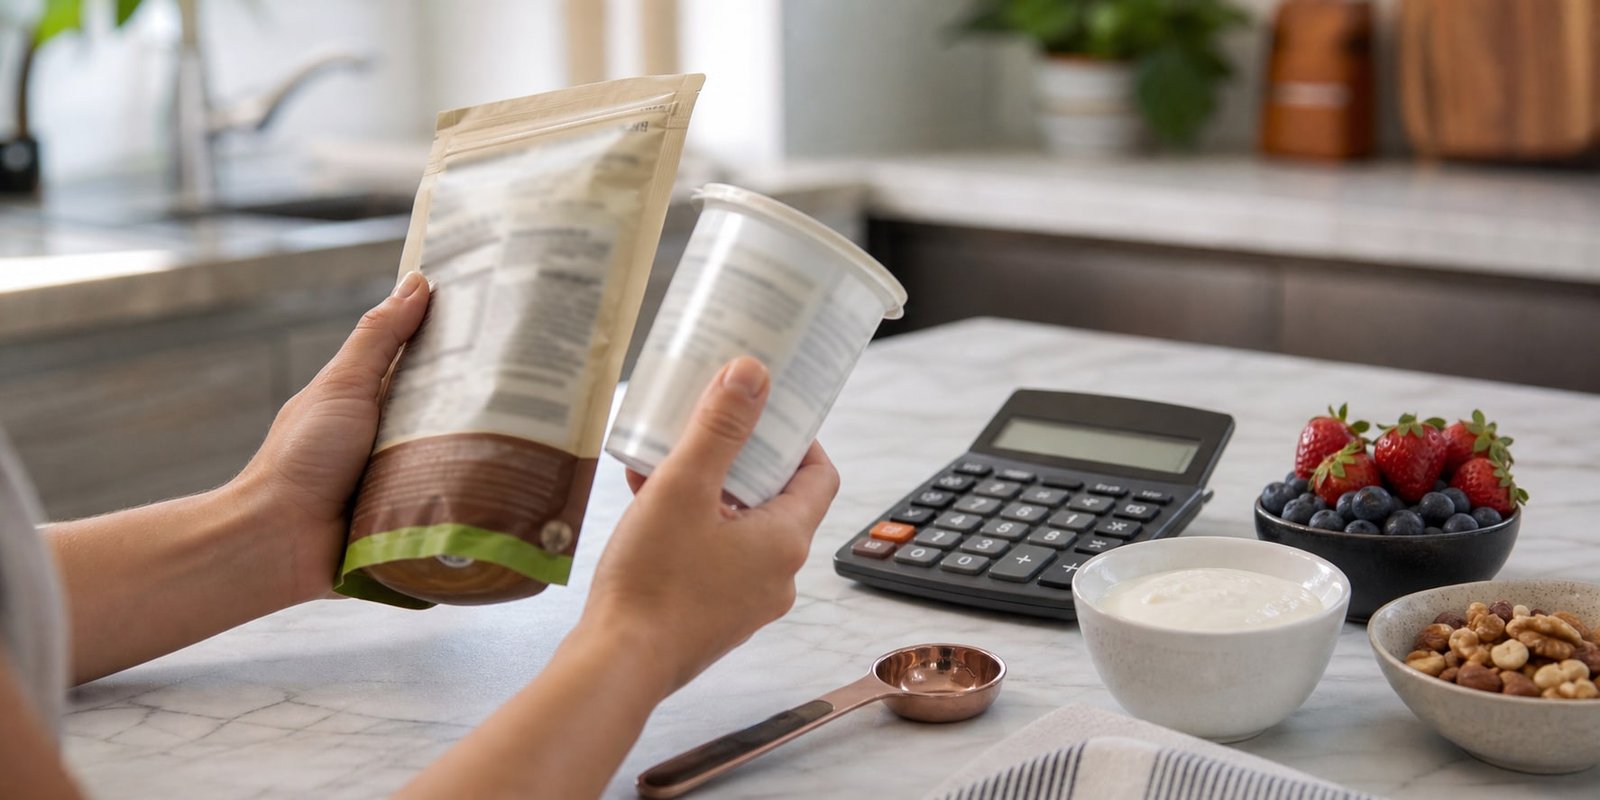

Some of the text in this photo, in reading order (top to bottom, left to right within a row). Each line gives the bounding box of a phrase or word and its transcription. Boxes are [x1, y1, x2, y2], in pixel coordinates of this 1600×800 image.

[950, 515, 965, 525] 4
[976, 540, 993, 550] 3
[910, 548, 926, 558] 0
[957, 556, 973, 565] 0
[1016, 554, 1031, 564] +
